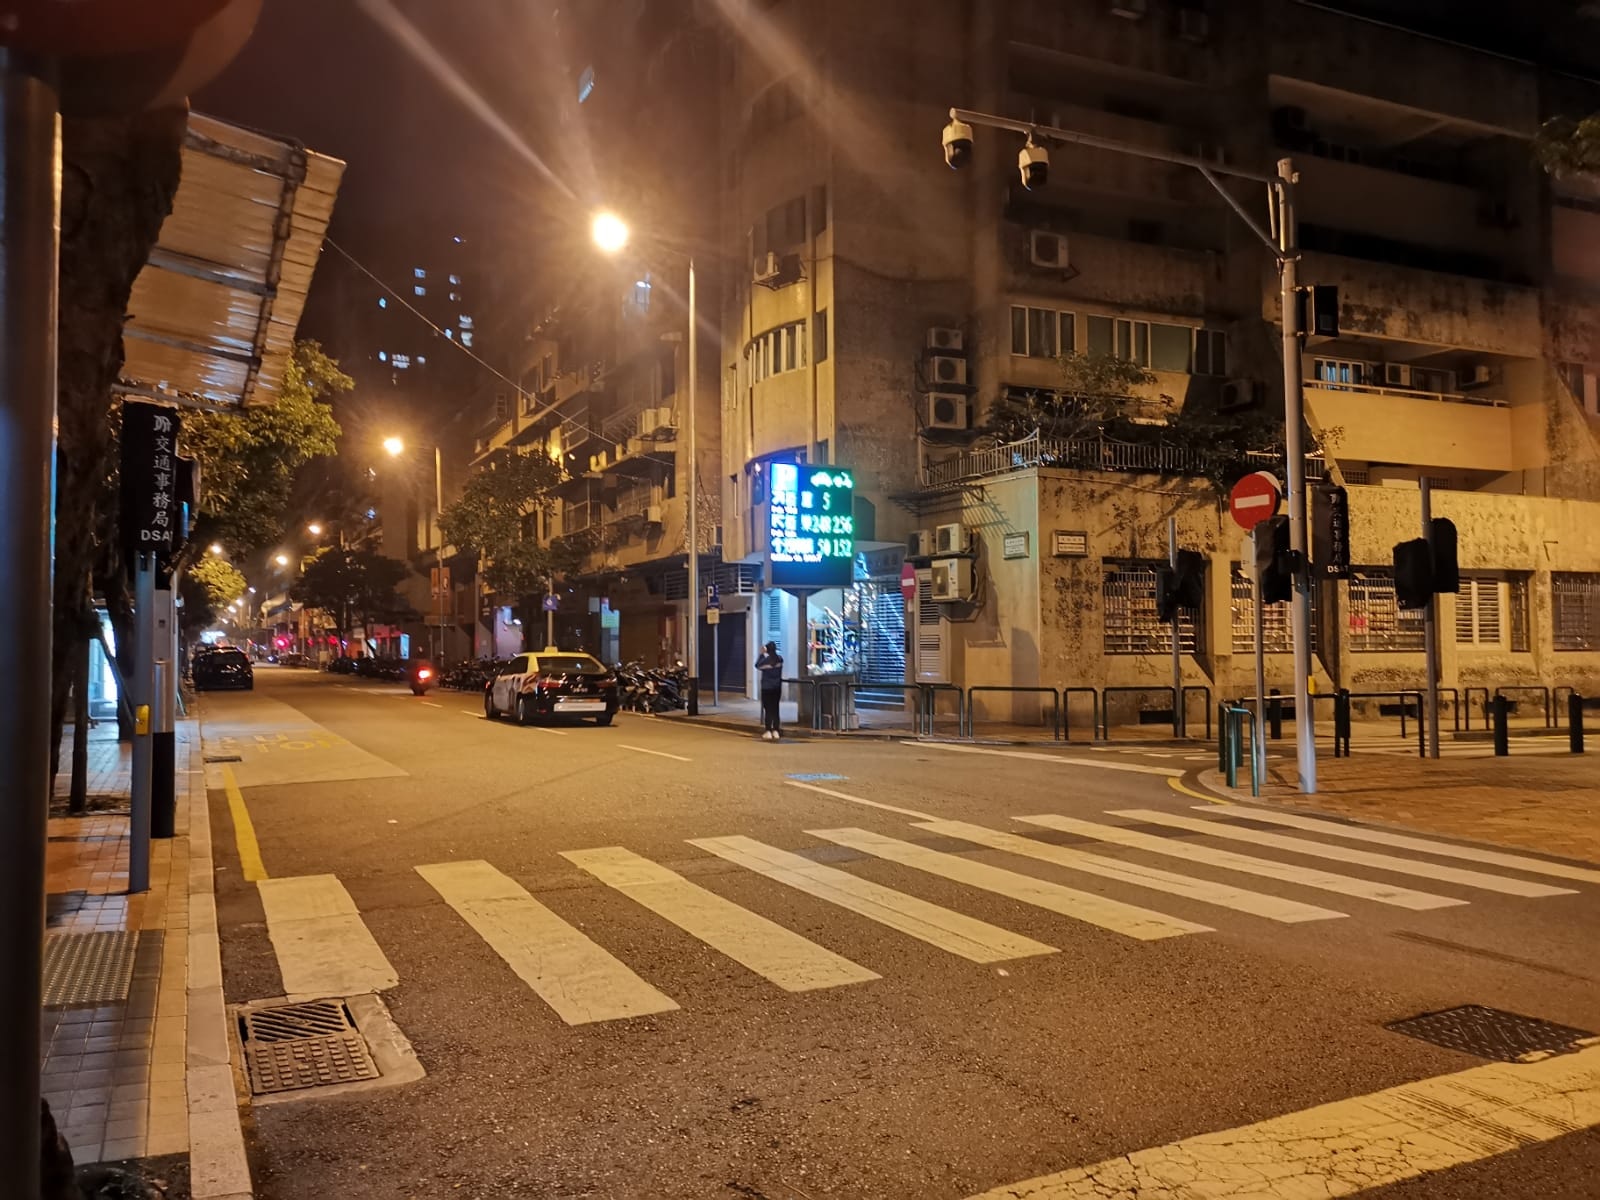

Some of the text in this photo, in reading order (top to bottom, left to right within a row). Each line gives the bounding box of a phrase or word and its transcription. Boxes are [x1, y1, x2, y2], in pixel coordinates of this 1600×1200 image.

[152, 435, 172, 528] 交通事務局
[140, 529, 173, 542] DSA
